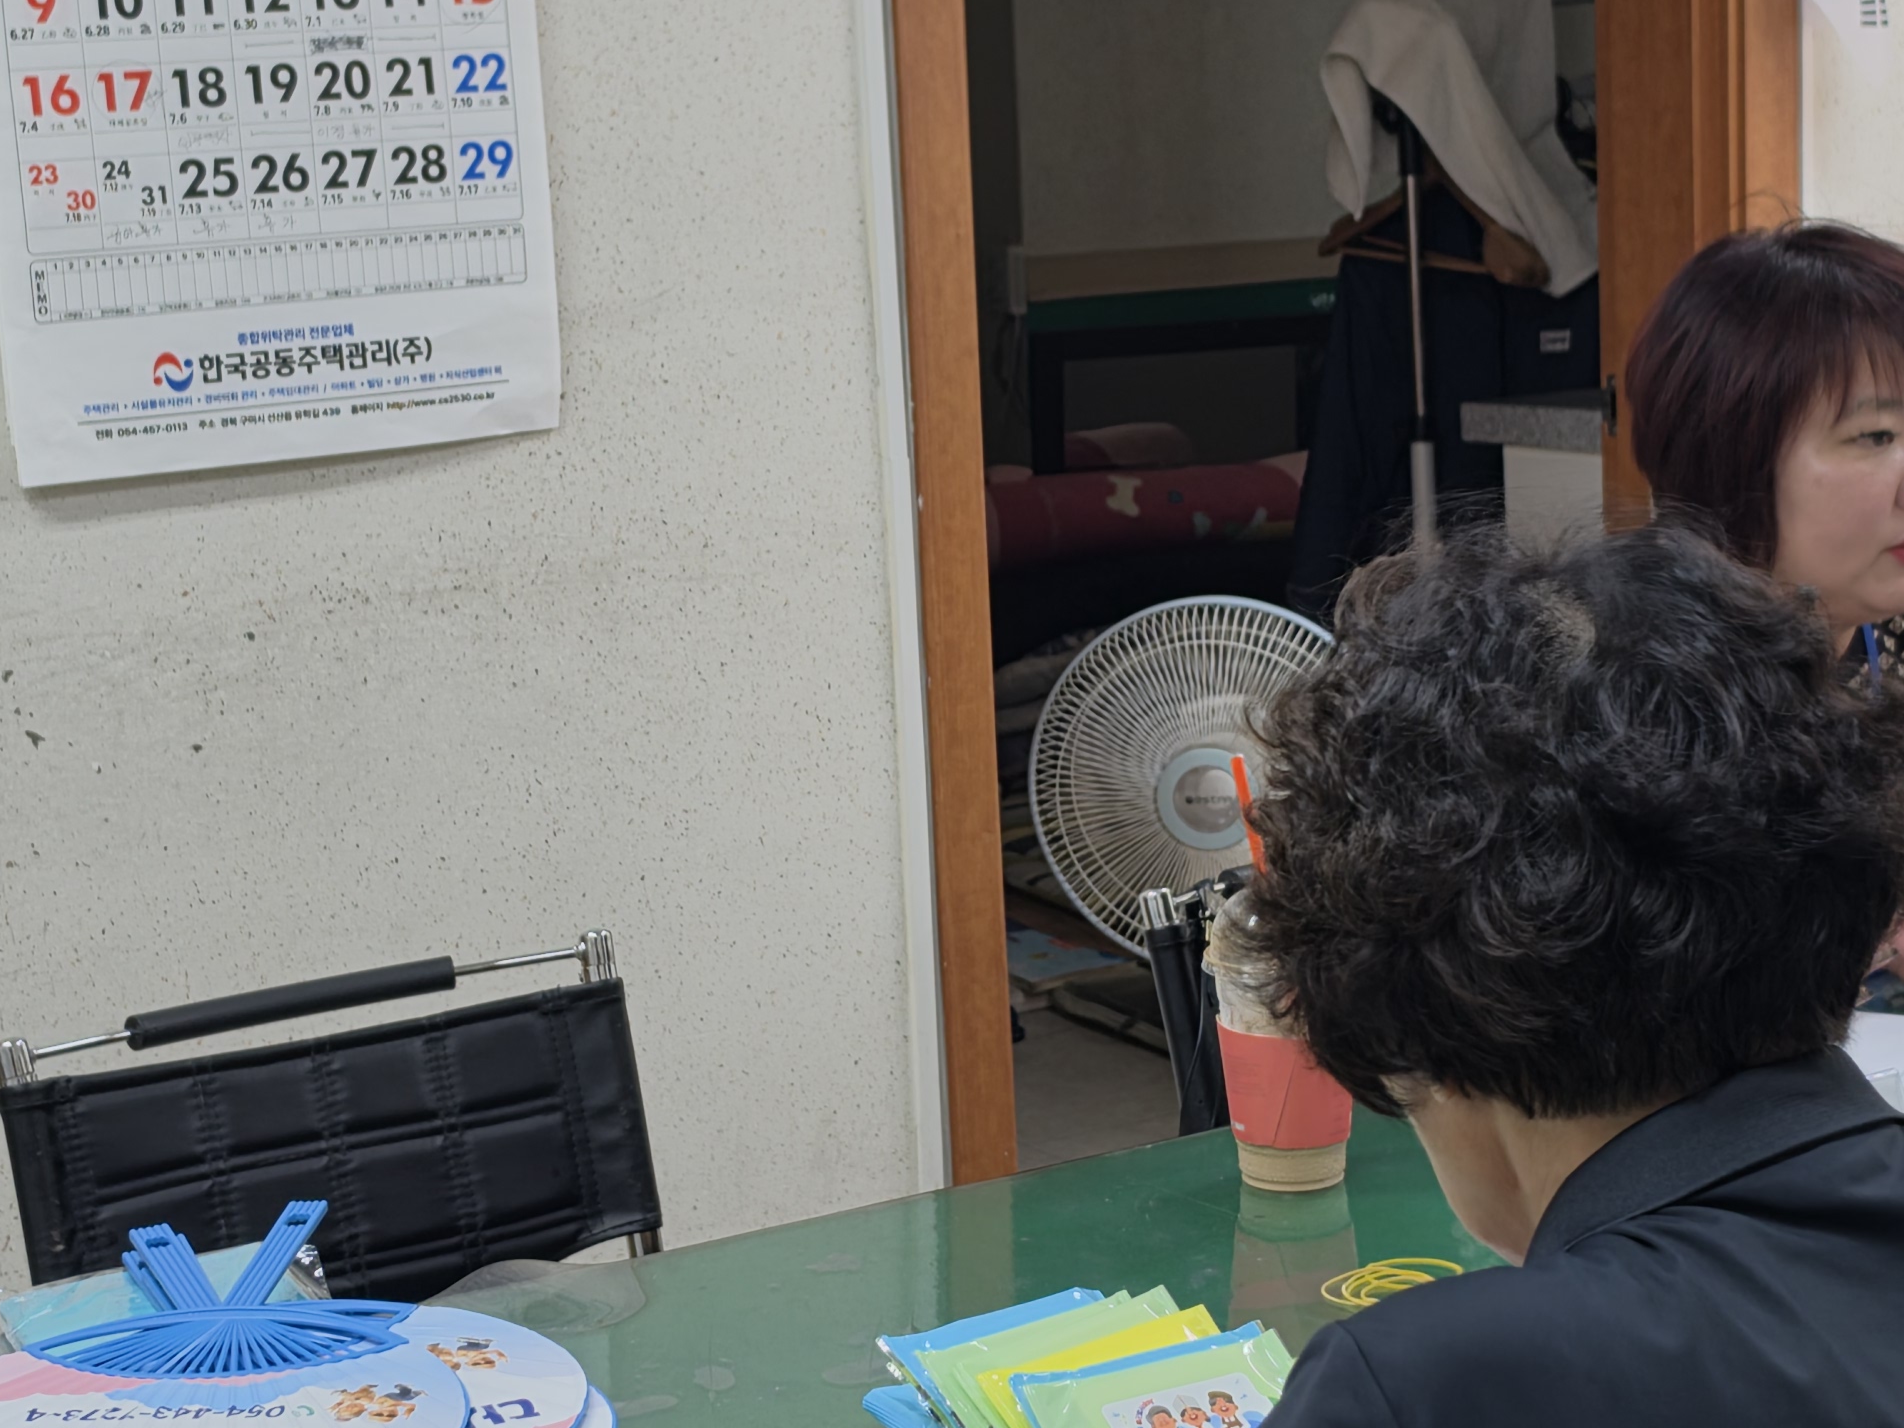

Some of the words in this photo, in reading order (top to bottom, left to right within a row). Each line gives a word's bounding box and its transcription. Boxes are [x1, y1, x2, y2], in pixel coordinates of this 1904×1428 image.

[10, 28, 34, 40] 6.27
[85, 26, 110, 37] 6.28
[161, 22, 185, 34] 6.29
[234, 19, 258, 30] 6.30
[305, 16, 321, 28] 7.1
[22, 74, 80, 117] 16
[97, 70, 152, 112] 17
[172, 67, 227, 108] 18
[245, 64, 298, 104] 19
[314, 60, 371, 101] 20
[386, 56, 436, 97] 21
[452, 53, 508, 94] 22
[20, 122, 38, 133] 7.4
[170, 113, 187, 124] 7.6
[314, 104, 331, 116] 7.8
[383, 101, 399, 112] 7.9
[452, 98, 473, 108] 7.10
[28, 164, 58, 186] 23
[102, 160, 131, 180] 24
[179, 157, 238, 200] 25
[250, 154, 310, 194] 26
[321, 148, 378, 190] 27
[391, 144, 448, 185] 28
[459, 140, 513, 180] 29
[66, 190, 96, 212] 30
[142, 186, 167, 206] 31
[309, 323, 355, 340] 전문업체
[198, 336, 433, 384] 한국공동주택관리(주)
